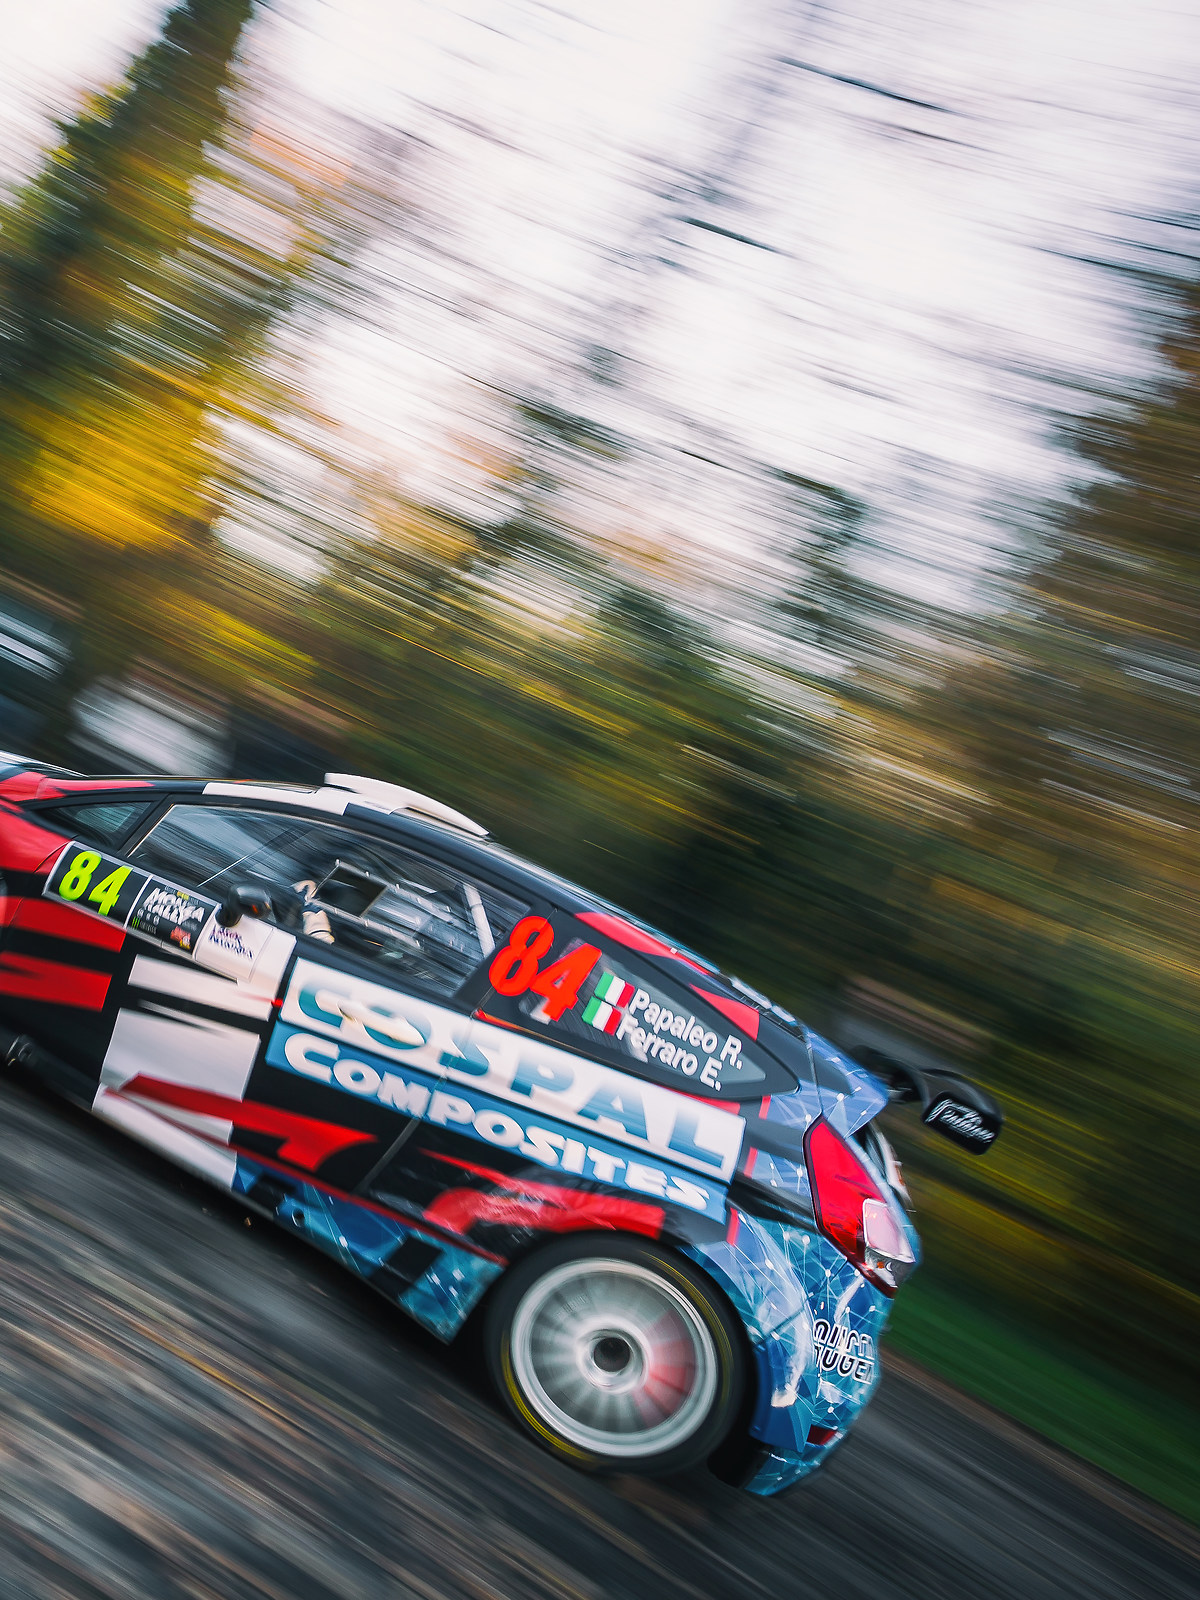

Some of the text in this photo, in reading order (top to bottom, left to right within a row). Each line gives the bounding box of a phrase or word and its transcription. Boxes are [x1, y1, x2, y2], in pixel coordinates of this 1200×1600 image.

[58, 850, 134, 917] 84
[489, 915, 603, 1022] 84
[298, 982, 726, 1170] COSPAL
[616, 1013, 723, 1092] Ferraro E.
[628, 988, 744, 1070] Papaleo R.
[284, 1032, 711, 1212] COMPOSITES
